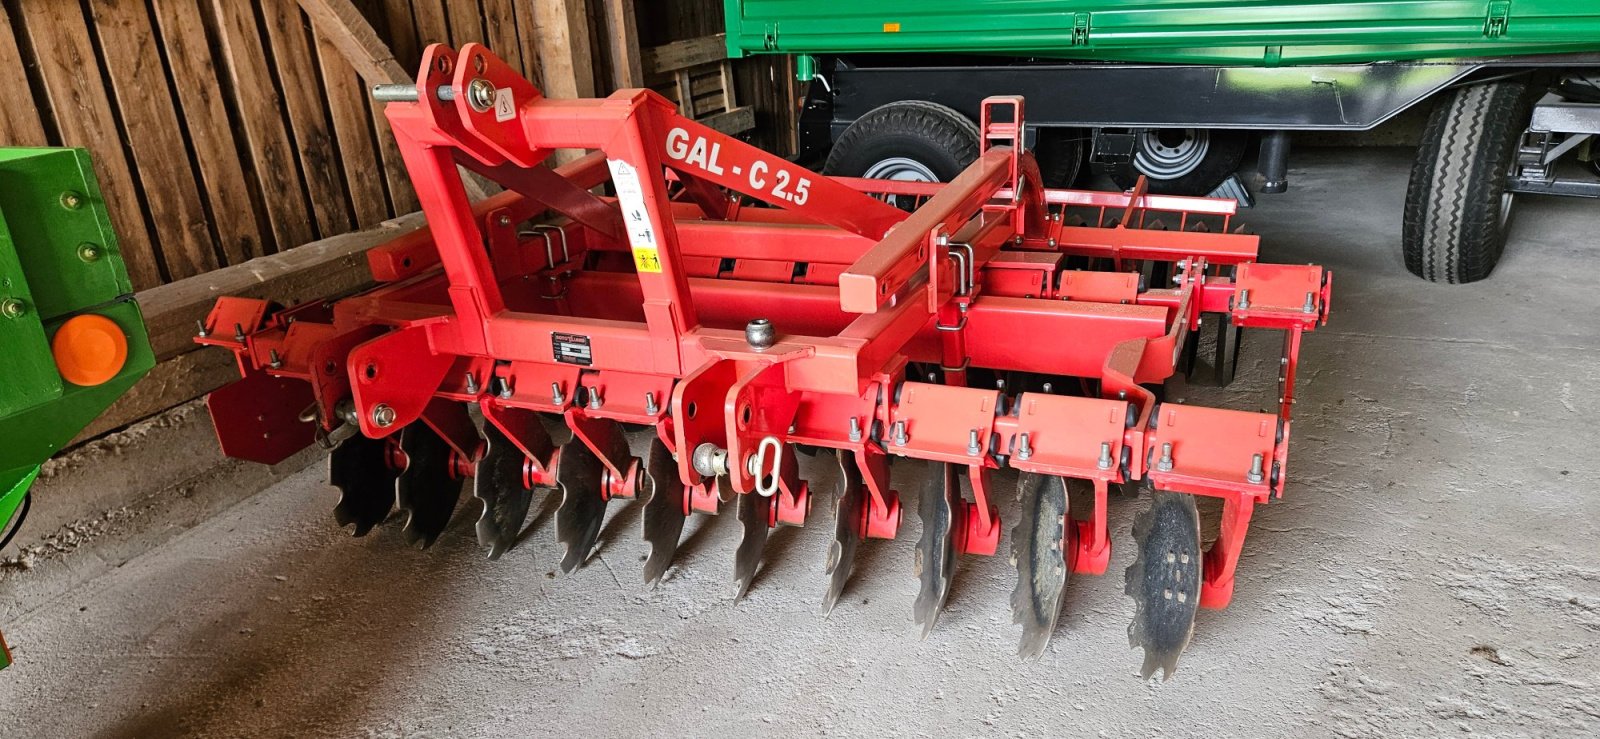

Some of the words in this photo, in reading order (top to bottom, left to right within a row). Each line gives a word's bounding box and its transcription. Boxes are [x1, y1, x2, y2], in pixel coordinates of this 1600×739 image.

[666, 128, 724, 176] GAL
[732, 166, 741, 175] -
[749, 160, 768, 189] C
[772, 169, 811, 206] 2.5
